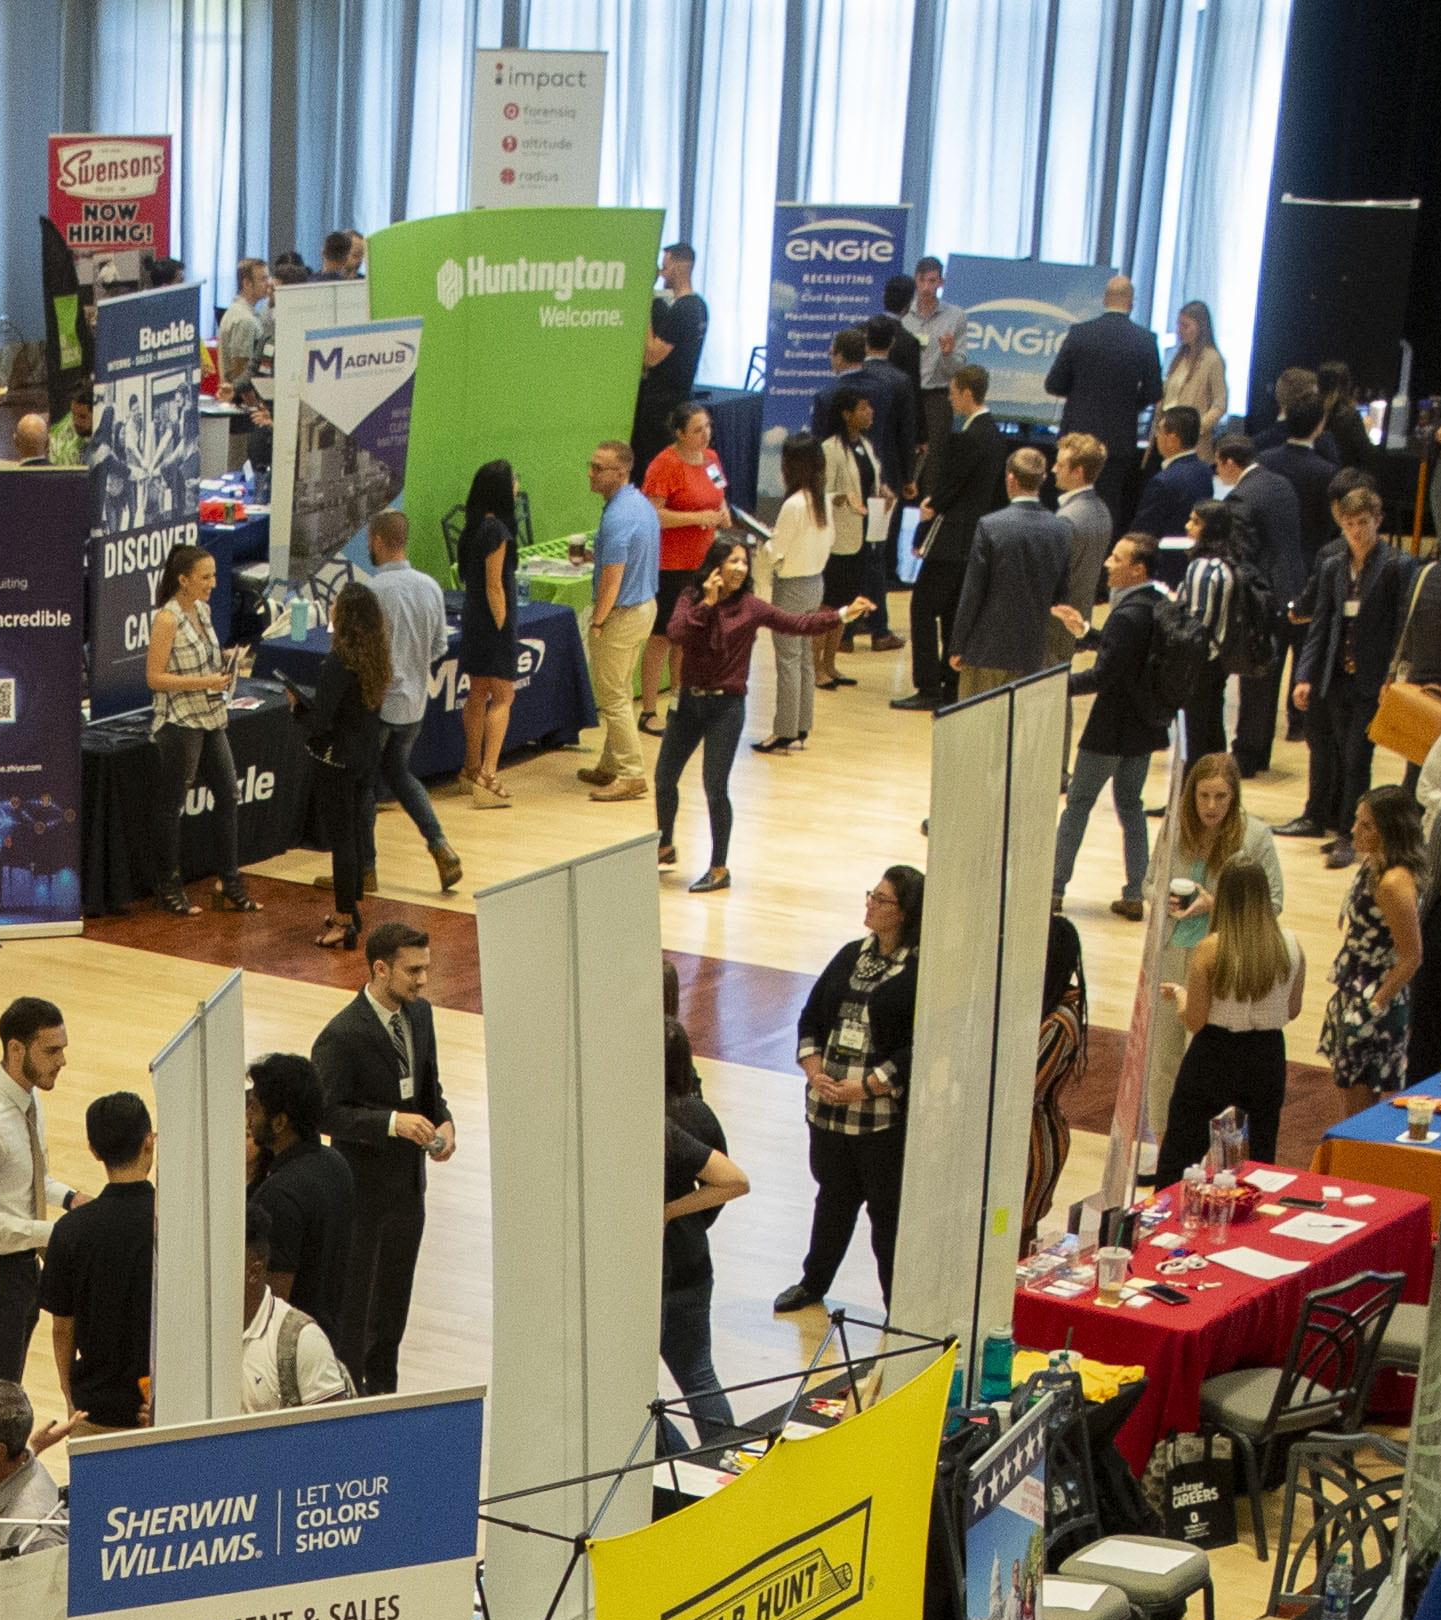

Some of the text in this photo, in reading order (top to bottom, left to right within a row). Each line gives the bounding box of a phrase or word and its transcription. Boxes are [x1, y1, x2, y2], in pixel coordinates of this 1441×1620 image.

[509, 67, 587, 92] impact
[58, 148, 165, 188] Swensons
[83, 204, 138, 223] NOW
[67, 223, 153, 245] HIRING!
[466, 255, 625, 300] Huntington
[802, 274, 873, 284] RECRUITING
[539, 306, 625, 328] Welcome.
[139, 323, 194, 351] Buckle
[307, 346, 407, 383] MAGNUS
[104, 522, 198, 579] DISCOVER
[297, 1475, 389, 1507] LET YOUR
[1173, 1487, 1219, 1509] CAREERS
[103, 1494, 257, 1543] SHERWIN
[297, 1500, 380, 1531] COLORS
[296, 1525, 361, 1553] SHOW
[100, 1532, 256, 1581] WILLIAMS
